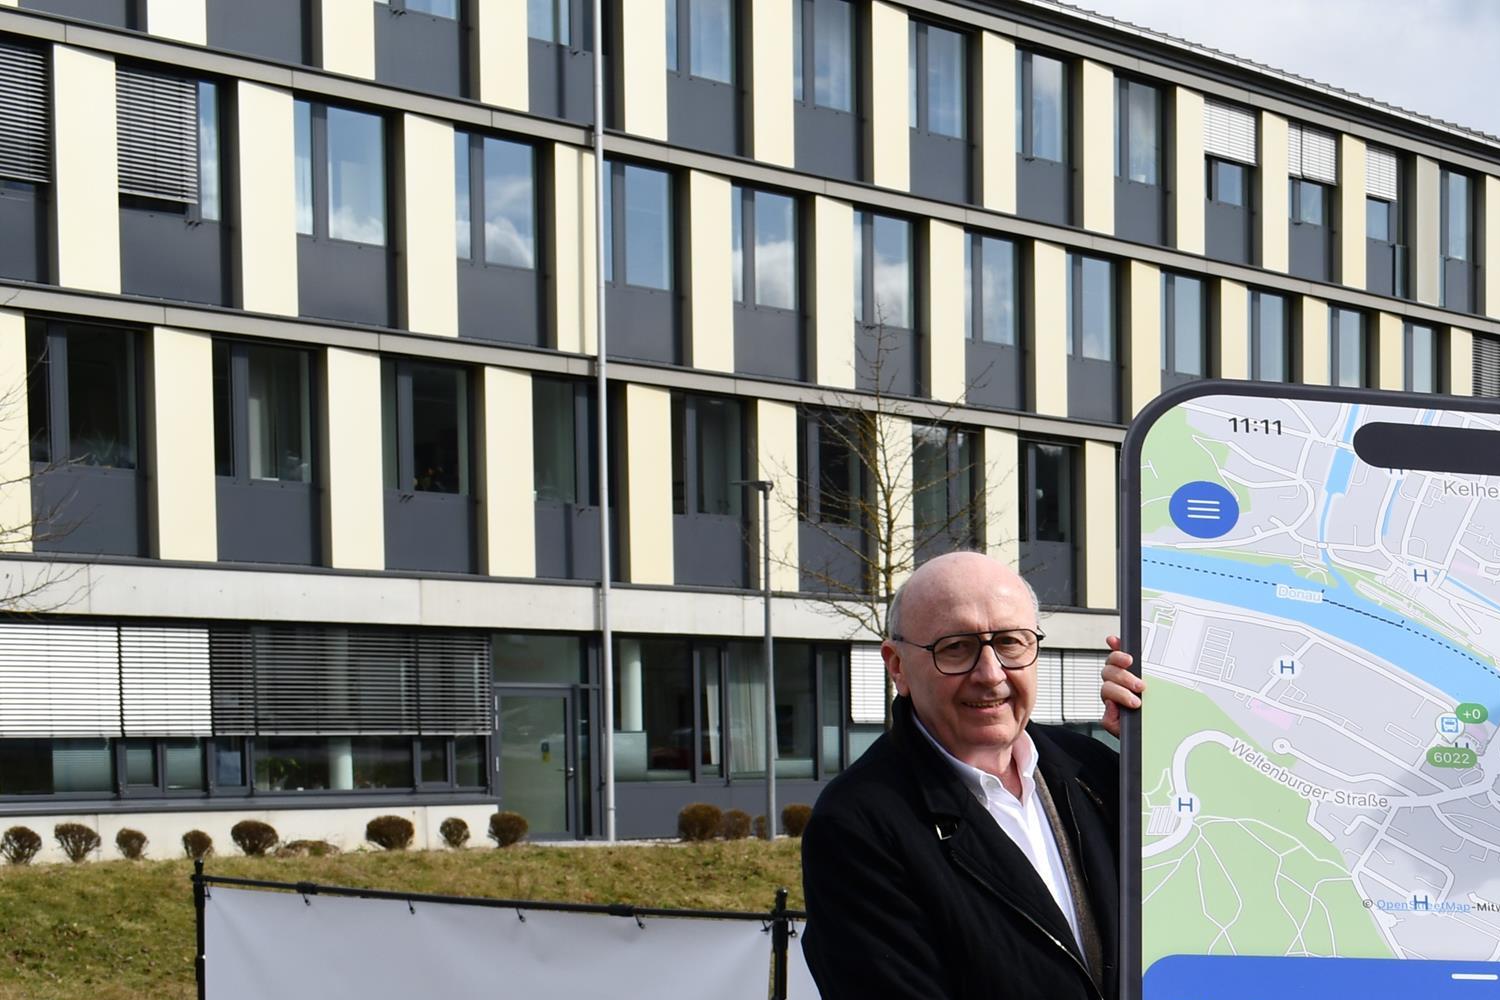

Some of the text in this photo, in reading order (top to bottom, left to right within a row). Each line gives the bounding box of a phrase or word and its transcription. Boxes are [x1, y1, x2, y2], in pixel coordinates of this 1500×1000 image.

[1228, 417, 1283, 436] 11:11
[1414, 569, 1428, 583] H
[1278, 585, 1323, 601] Donau
[1280, 660, 1295, 675] H
[1463, 709, 1481, 720] +0
[1433, 752, 1470, 765] 6022
[1232, 739, 1389, 808] Weltenburger Straße
[1178, 797, 1193, 812] H
[1414, 895, 1428, 910] H
